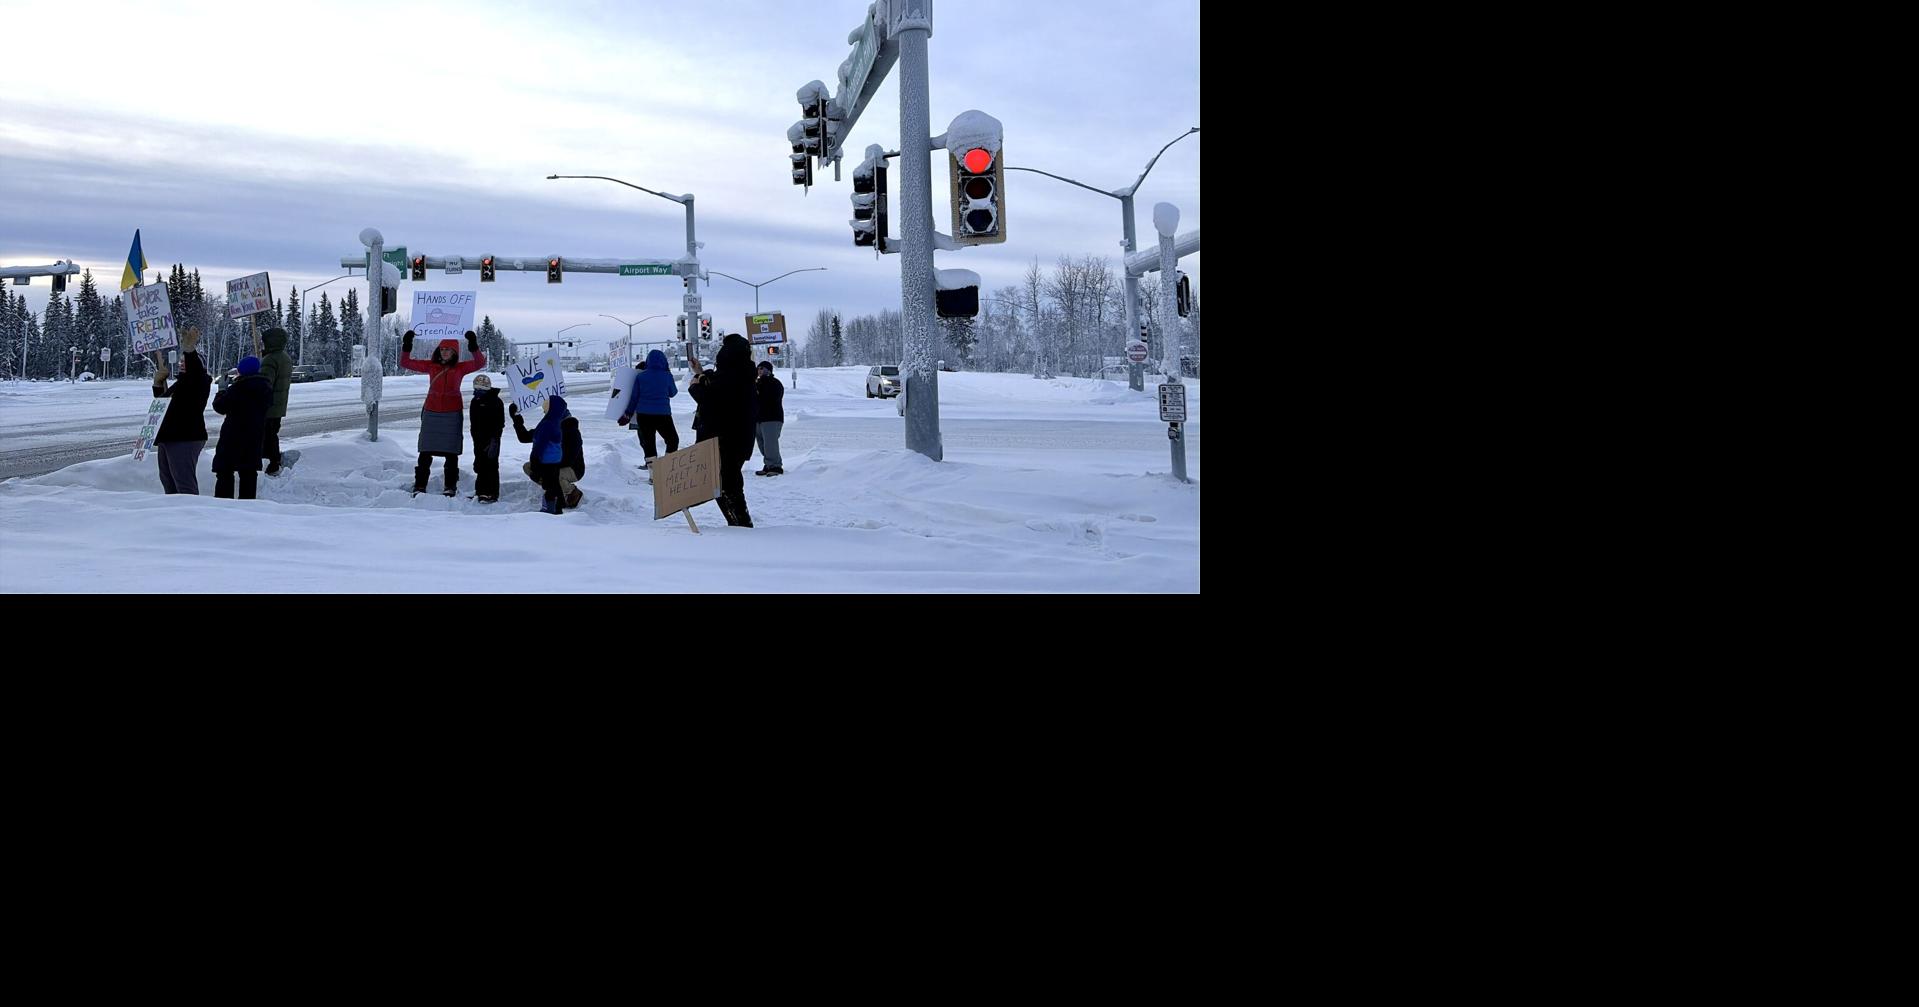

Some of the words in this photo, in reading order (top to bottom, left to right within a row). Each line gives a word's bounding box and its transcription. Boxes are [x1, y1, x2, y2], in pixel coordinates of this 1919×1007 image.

[652, 266, 668, 274] Way
[417, 292, 447, 305] HANDS
[449, 293, 473, 305] OFF
[136, 305, 160, 319] take
[130, 312, 174, 336] FREEDOM
[413, 322, 465, 336] Greenland
[516, 356, 543, 377] WE
[671, 449, 697, 471] ICE
[664, 466, 693, 487] MELT
[695, 463, 707, 473] IN
[669, 479, 698, 496] HELL
